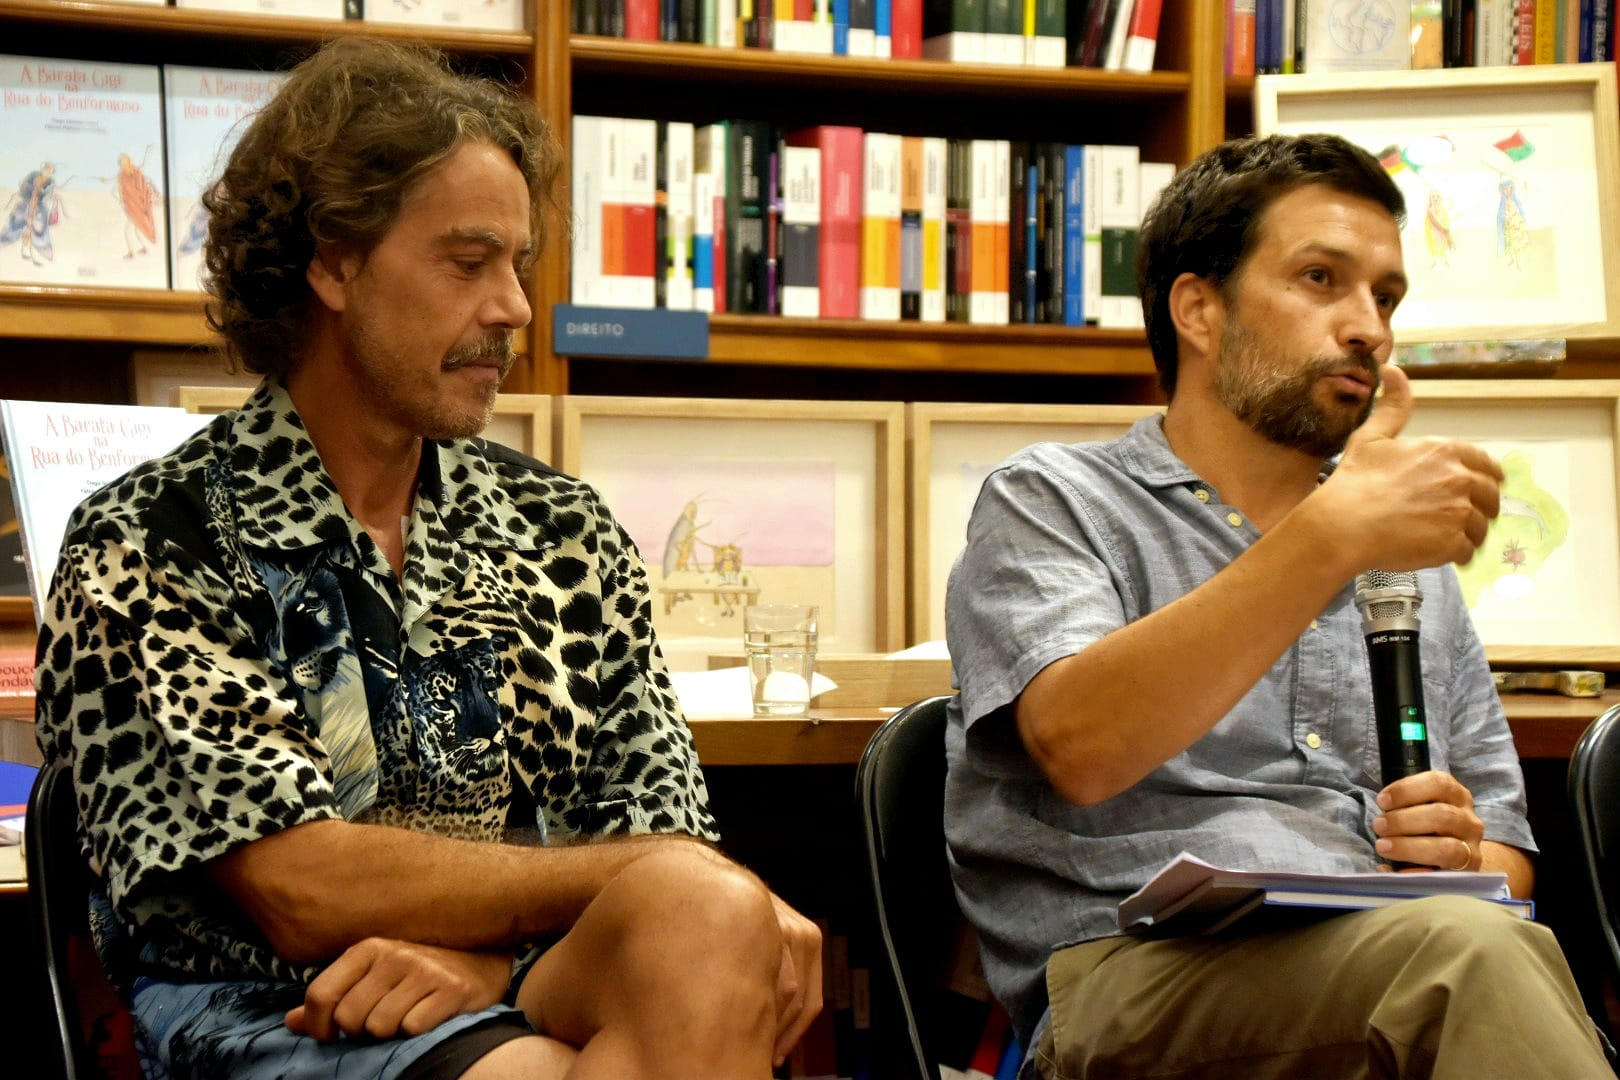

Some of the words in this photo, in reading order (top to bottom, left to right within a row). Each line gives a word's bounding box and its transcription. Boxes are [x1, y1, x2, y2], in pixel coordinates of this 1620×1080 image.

[20, 64, 33, 86] A
[38, 65, 87, 88] Barata
[3, 88, 31, 108] Rua
[36, 91, 52, 108] do
[184, 99, 209, 120] Rua
[566, 322, 625, 337] DIREITO
[46, 415, 59, 438] A
[61, 415, 115, 438] Barata
[93, 436, 109, 449] na
[30, 446, 60, 470] Rua
[66, 447, 83, 466] do
